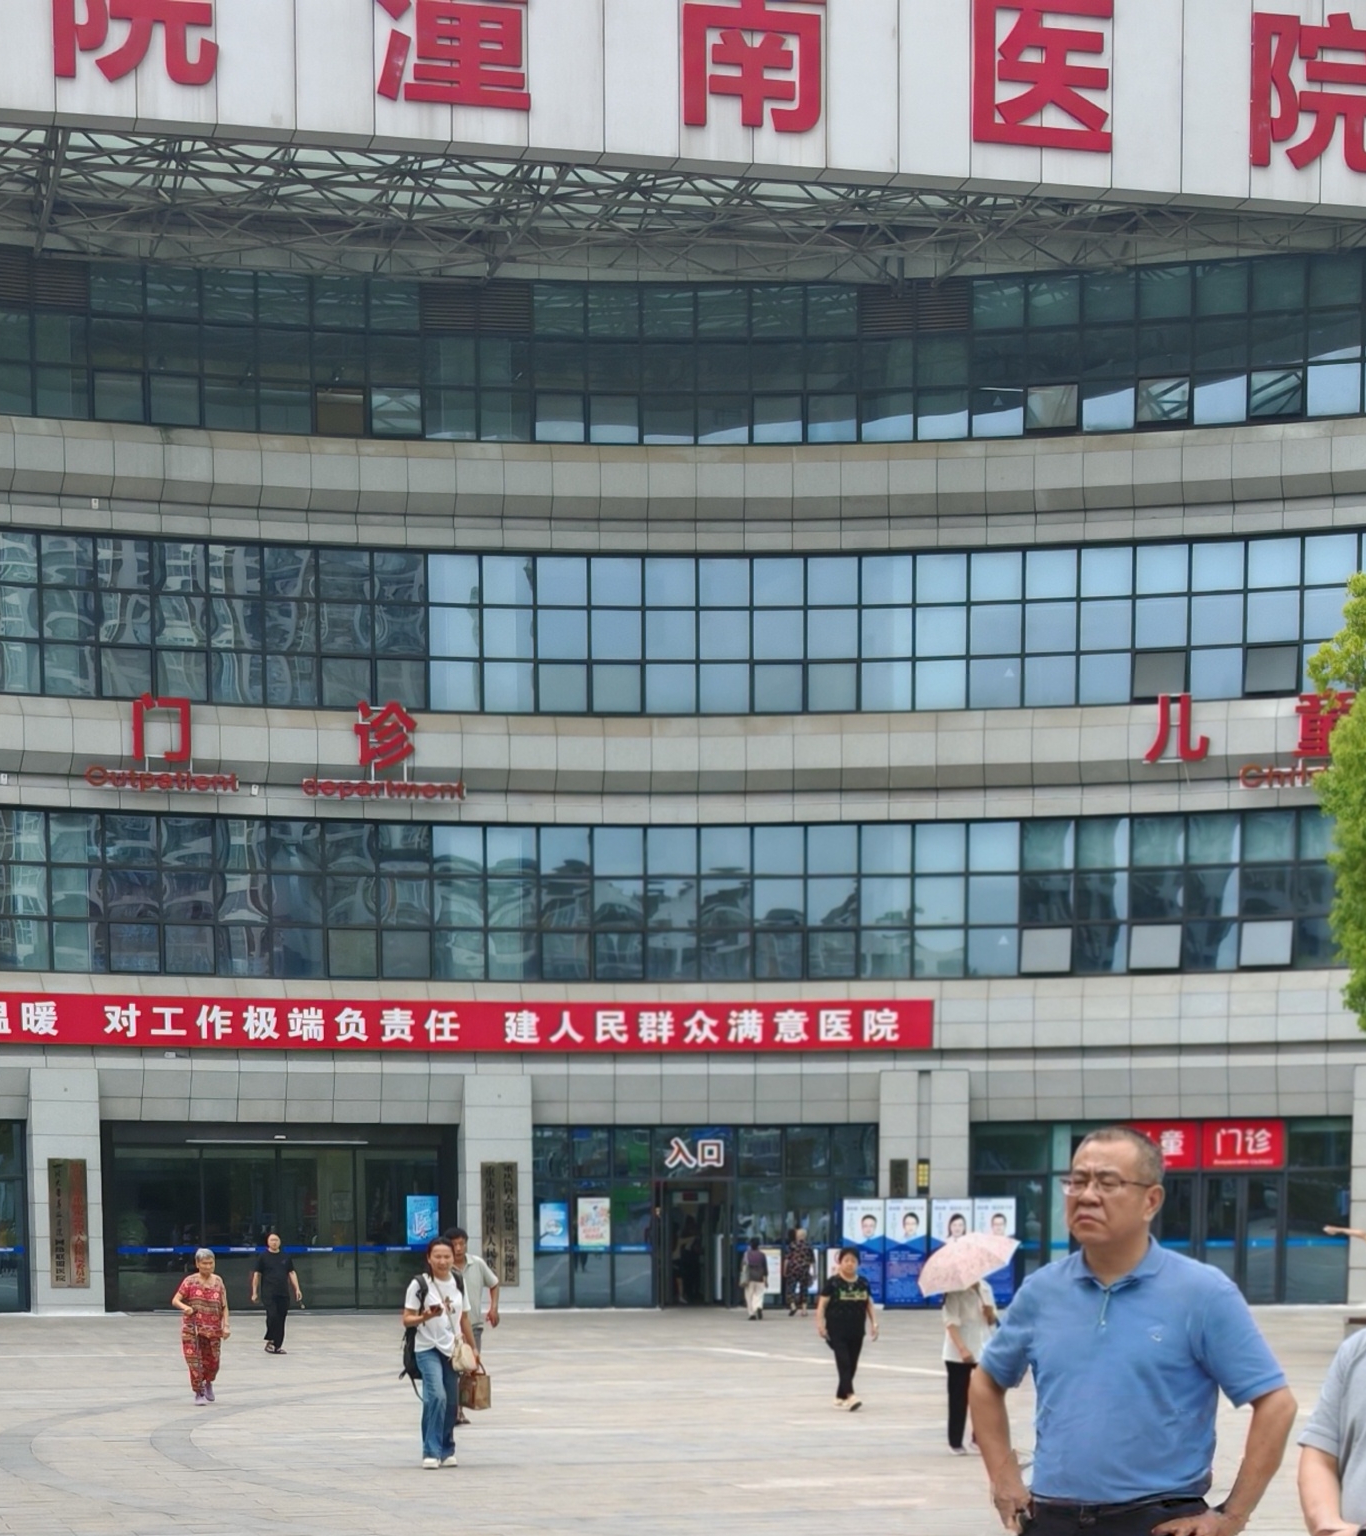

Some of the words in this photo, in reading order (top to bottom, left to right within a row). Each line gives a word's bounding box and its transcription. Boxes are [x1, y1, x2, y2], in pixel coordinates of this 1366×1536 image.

[133, 692, 418, 771] 门诊
[302, 776, 467, 801] department
[103, 1004, 461, 1042] 对工作极端负责任
[504, 1008, 900, 1045] 建人民群众满意医院
[665, 1137, 724, 1168] 入口
[1216, 1128, 1272, 1156] 门诊
